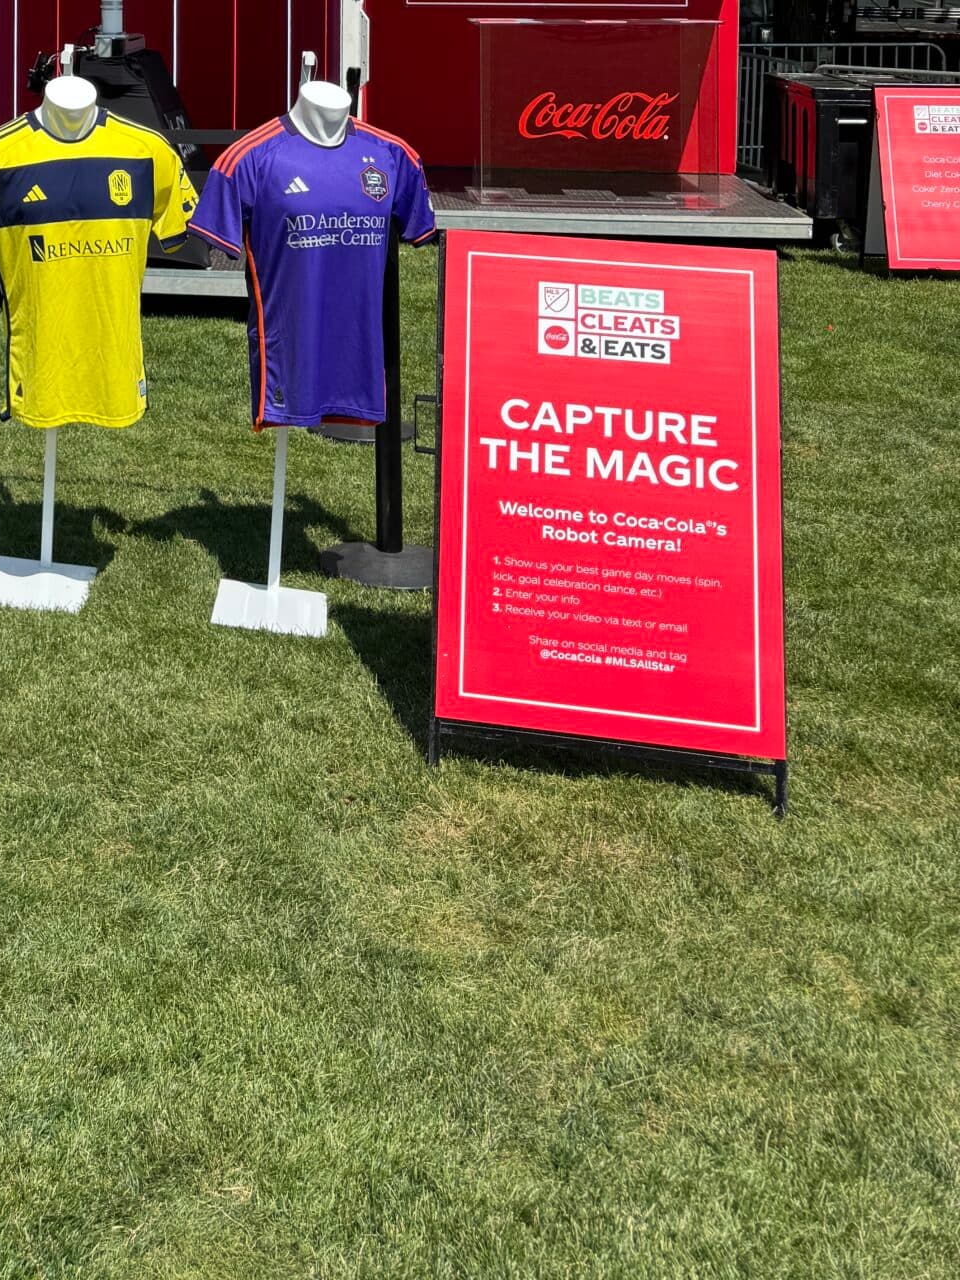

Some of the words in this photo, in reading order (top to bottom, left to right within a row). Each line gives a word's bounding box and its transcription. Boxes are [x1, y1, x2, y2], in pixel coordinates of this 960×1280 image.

[518, 91, 680, 140] Coca-Cola
[286, 214, 315, 232] MD
[317, 212, 385, 229] Anderson
[47, 237, 134, 259] RENASANT
[287, 233, 340, 248] Cancer
[341, 229, 384, 246] Center
[581, 288, 660, 309] BEATS
[580, 313, 676, 335] CLEATS
[580, 338, 598, 354] &
[604, 340, 666, 360] EATS
[500, 398, 718, 447] CAPTURE
[479, 437, 571, 477] THE
[586, 447, 739, 492] MAGIC
[498, 500, 584, 523] Welcome
[588, 509, 608, 525] to
[542, 525, 598, 544] Robot
[603, 532, 682, 552] Camera!
[493, 556, 501, 565] 1.
[504, 557, 533, 568] Show
[536, 562, 548, 570] us
[550, 564, 573, 572] your
[576, 565, 599, 575] best
[602, 568, 631, 579] game
[634, 571, 654, 582] day
[657, 574, 692, 585] moves
[492, 587, 502, 597] 2.
[505, 589, 533, 599] Enter
[535, 593, 559, 603] your
[561, 595, 581, 605] info
[493, 572, 515, 583] kick,
[518, 574, 541, 585] goal
[543, 577, 601, 591] celebration
[603, 584, 638, 596] dance,
[492, 603, 502, 613] 3.
[505, 604, 545, 617] Receive
[547, 611, 571, 620] your
[573, 613, 602, 623] video
[604, 616, 619, 625] via
[622, 617, 642, 628] text
[645, 621, 656, 629] or
[659, 622, 688, 633] email
[528, 635, 559, 648] Share
[561, 640, 575, 649] on
[577, 641, 607, 653] social
[610, 645, 643, 657] media
[646, 648, 666, 660] and
[669, 651, 687, 664] tag
[540, 648, 602, 664] @CocaCola
[604, 656, 676, 673] #MLSAllStar
